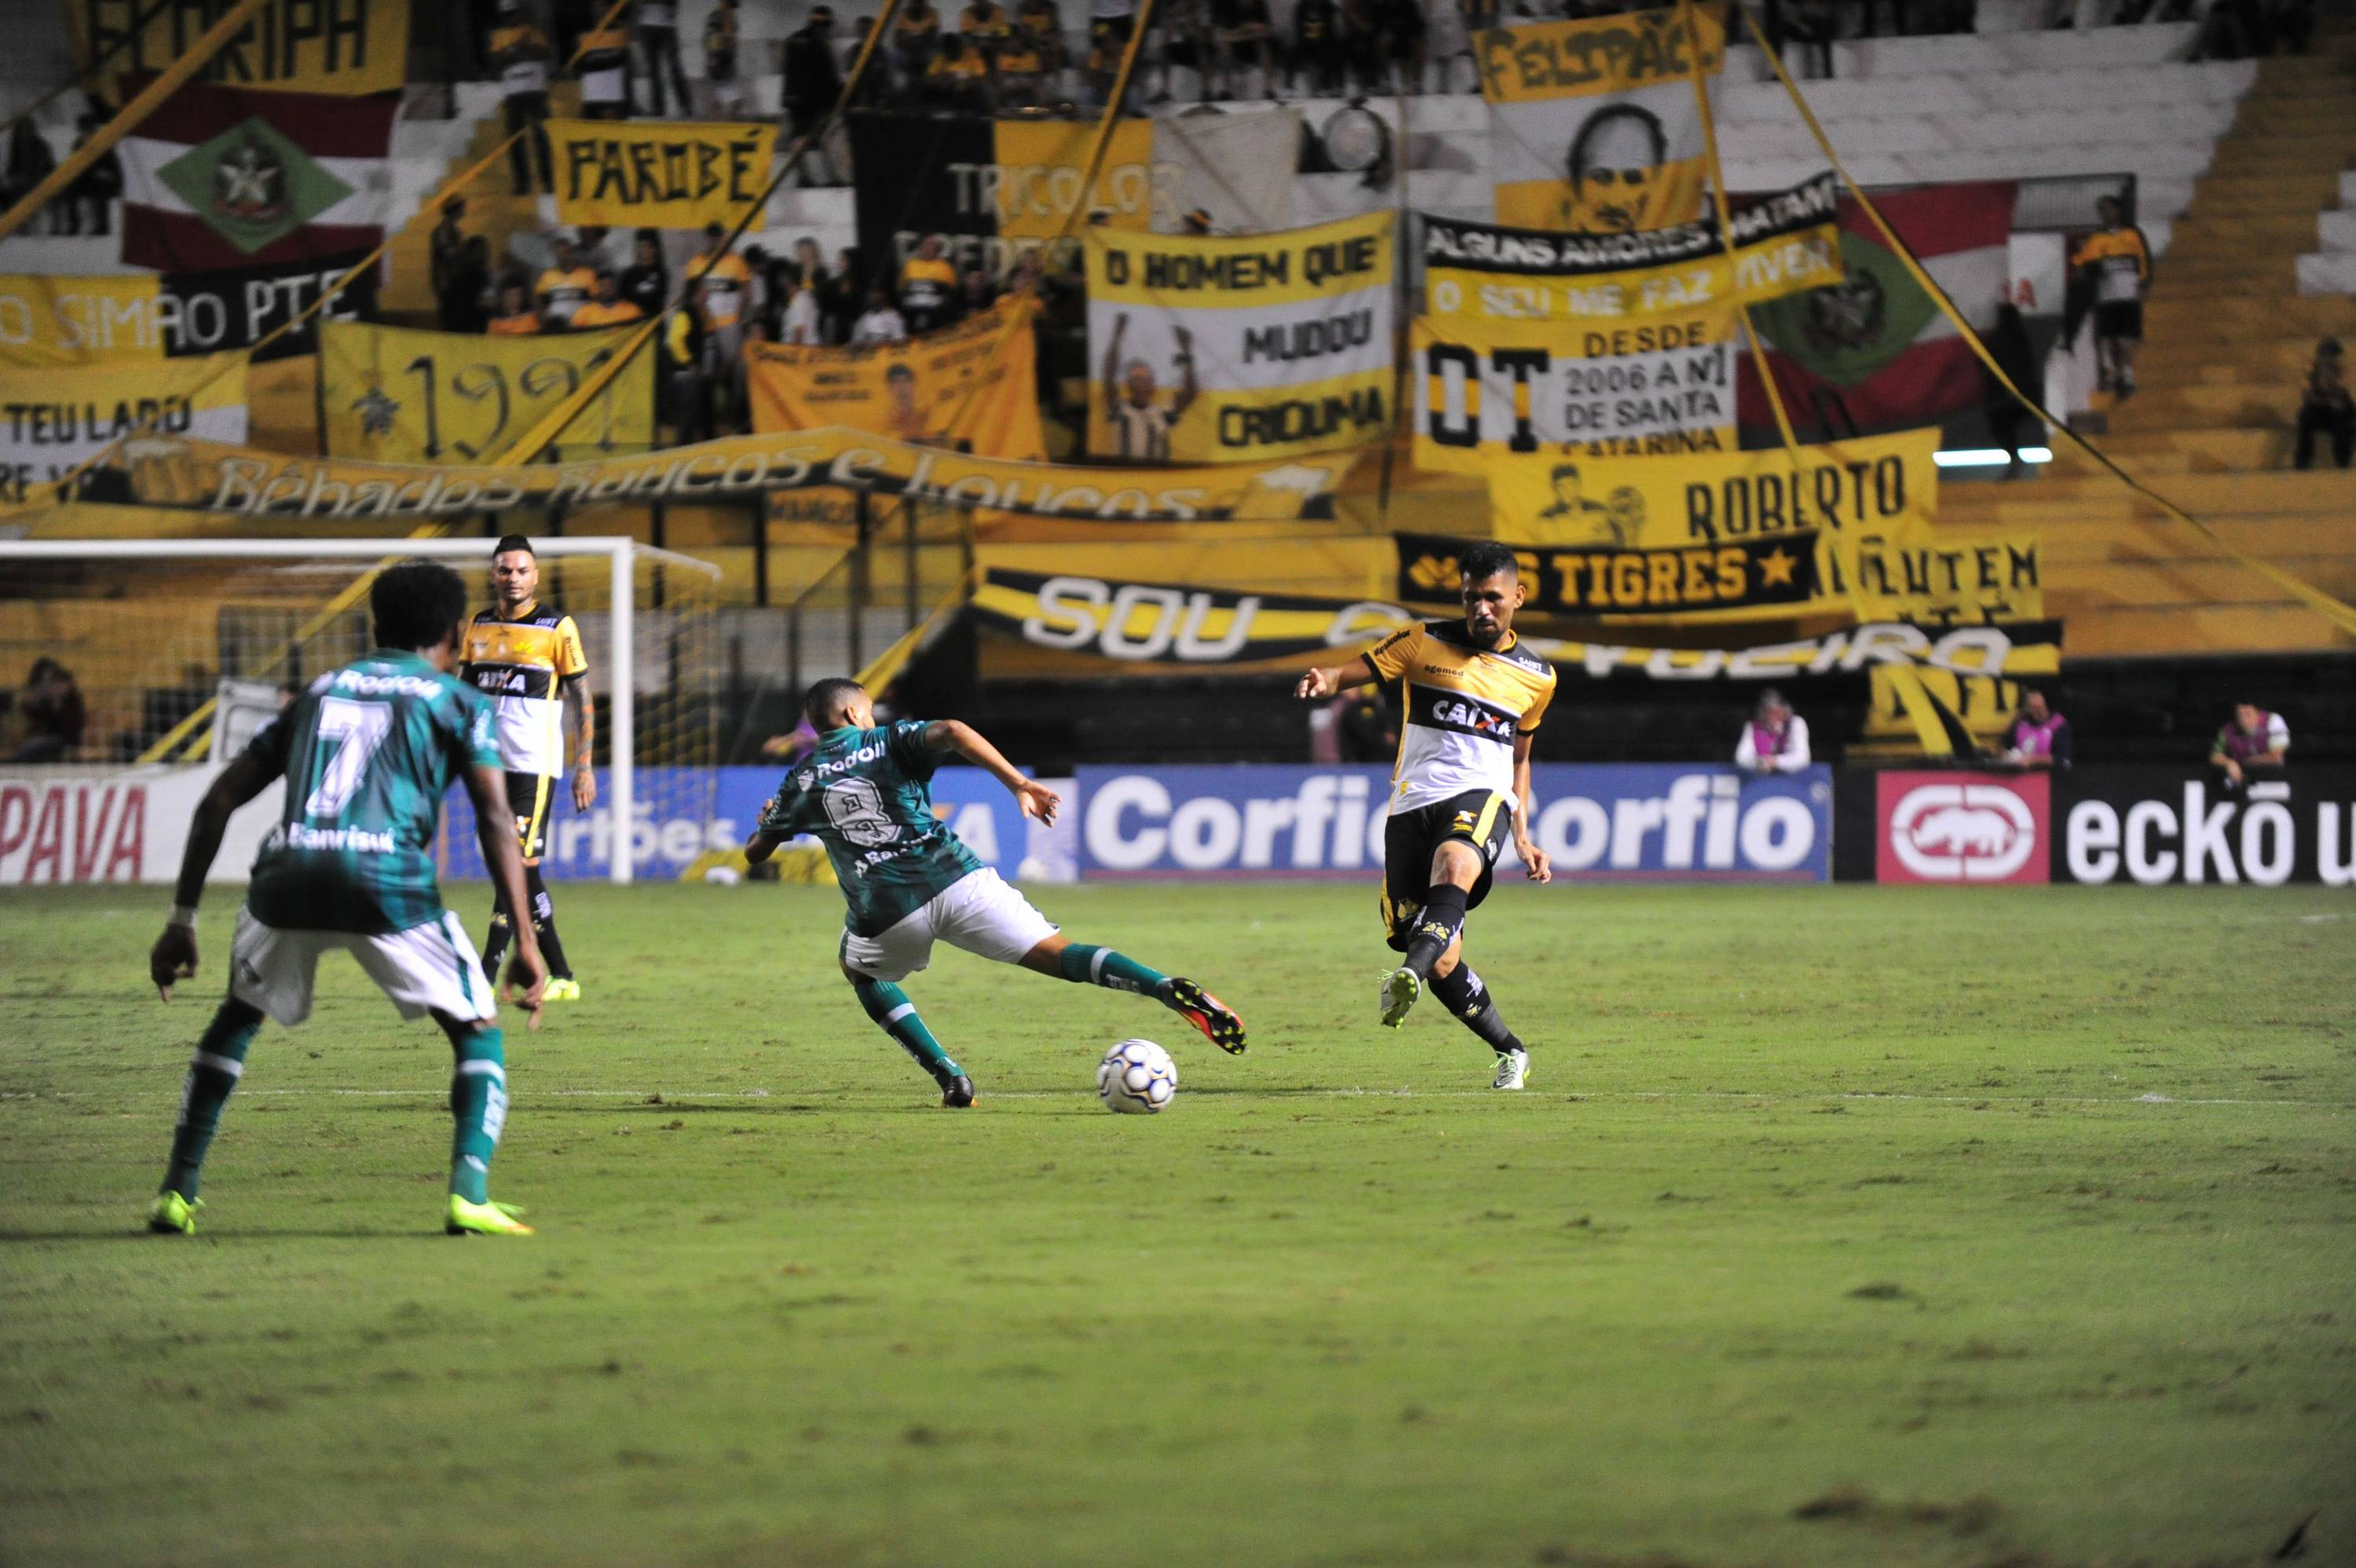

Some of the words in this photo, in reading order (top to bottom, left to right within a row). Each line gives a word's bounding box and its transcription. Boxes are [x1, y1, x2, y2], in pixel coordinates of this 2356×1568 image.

[1105, 248, 1129, 285] O
[1143, 248, 1290, 290] HOMEM
[1304, 236, 1377, 287] QUE
[1242, 307, 1373, 364] MUDOU
[1583, 321, 1707, 359] DESDE
[1564, 363, 1648, 395] 2006
[1654, 360, 1679, 387] A
[1564, 401, 1604, 430] DE
[1615, 391, 1721, 428] SANTA
[1685, 453, 1904, 543] ROBERTO
[1552, 547, 1749, 608] TIGRES
[1023, 576, 1263, 663] SOU
[1432, 699, 1513, 738] CAIXA
[305, 695, 393, 817] 7
[821, 776, 902, 847] 8
[1085, 773, 1385, 871] Corfi
[1517, 773, 1816, 871] orfio
